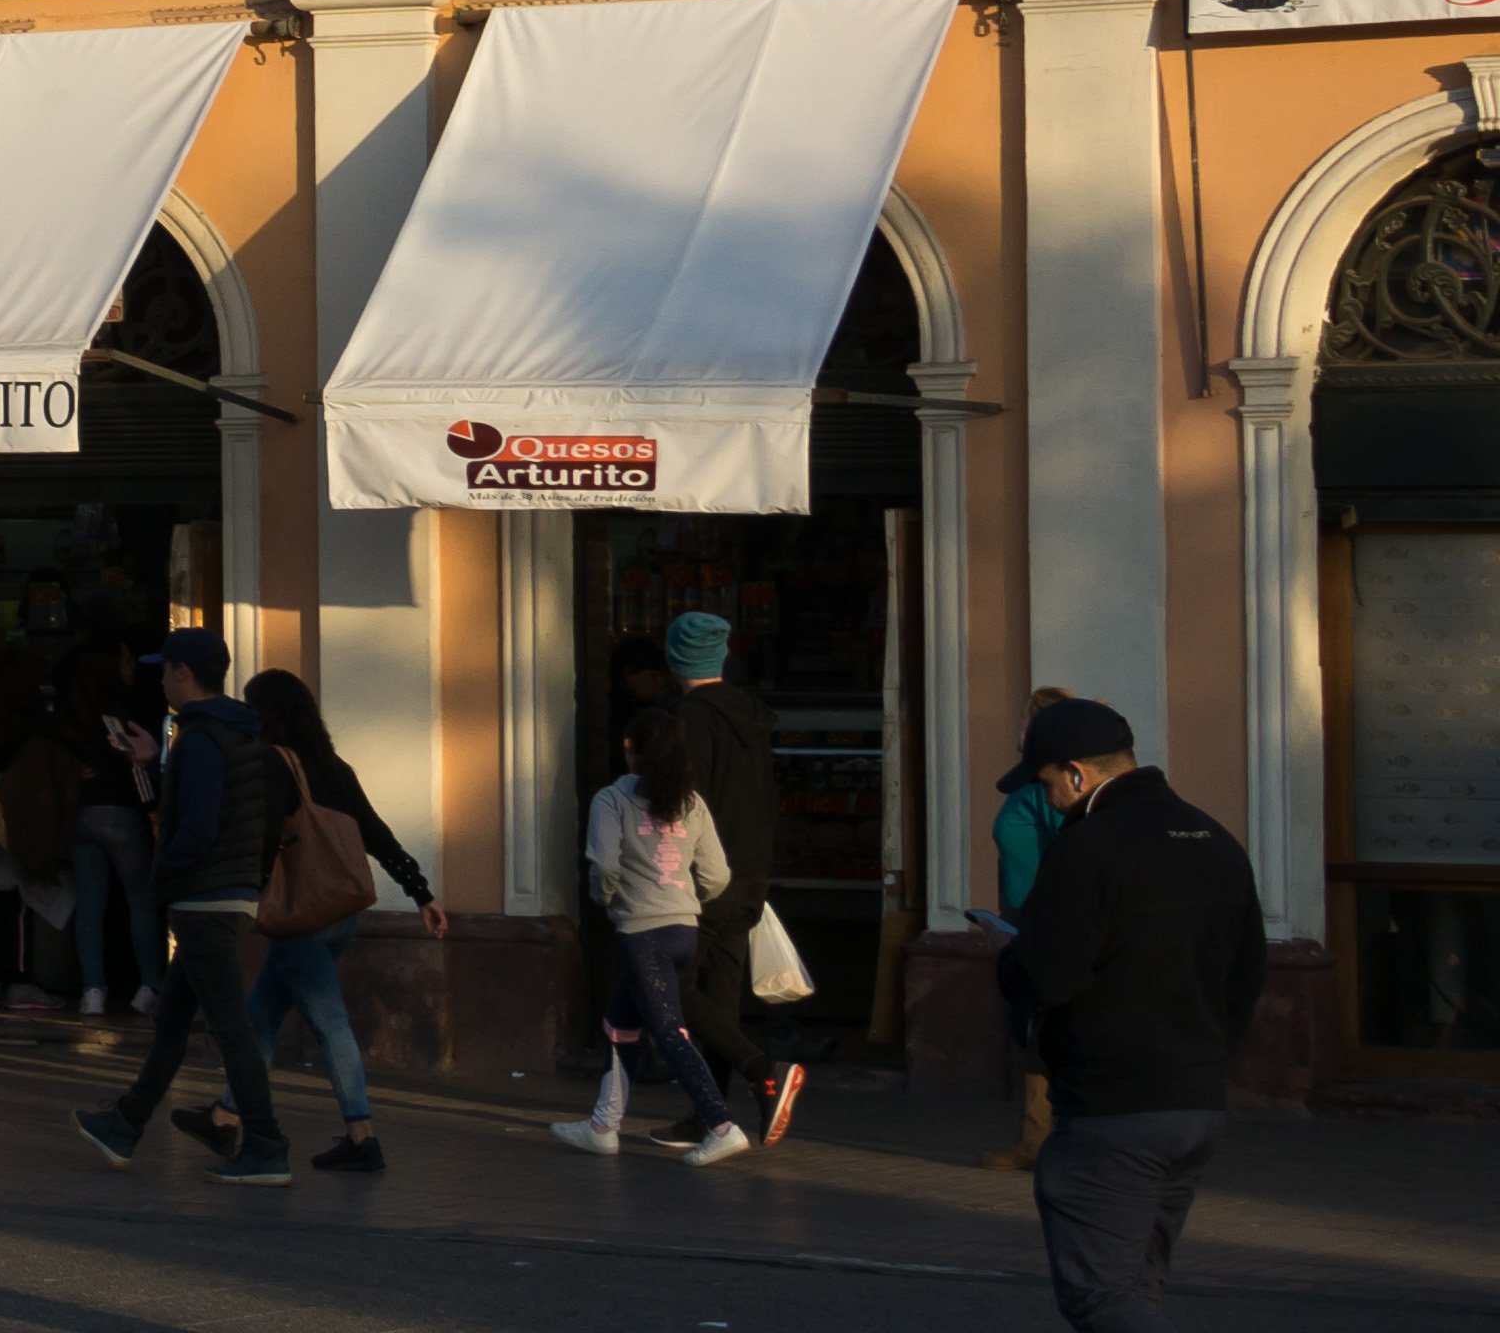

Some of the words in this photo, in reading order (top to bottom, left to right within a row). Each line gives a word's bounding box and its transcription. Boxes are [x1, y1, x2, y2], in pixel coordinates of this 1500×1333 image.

[510, 437, 654, 463] Quesos
[474, 463, 649, 486] Arturito
[500, 491, 515, 501] de
[574, 492, 591, 502] de
